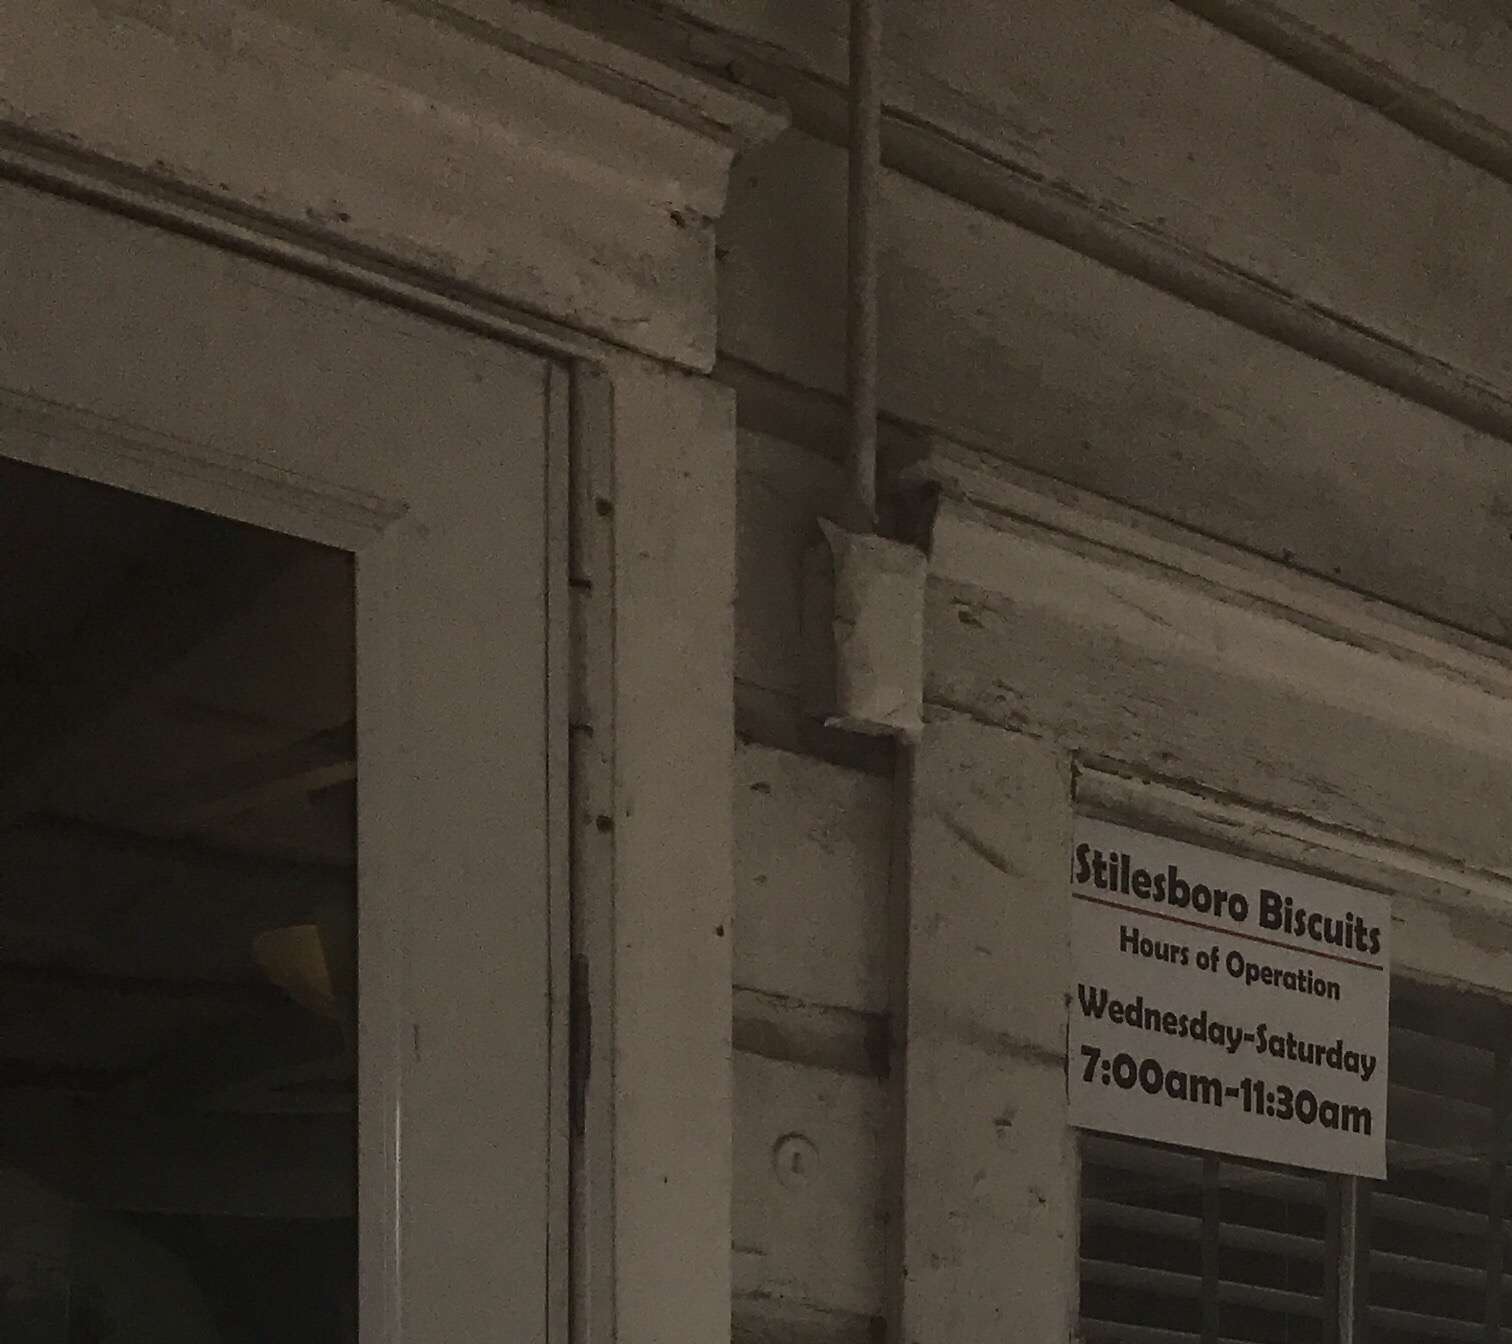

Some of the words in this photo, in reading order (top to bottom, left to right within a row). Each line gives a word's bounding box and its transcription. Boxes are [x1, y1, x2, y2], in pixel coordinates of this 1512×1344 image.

[1075, 843, 1249, 922] Stilesboro
[1258, 889, 1381, 955] Biscuits
[1119, 926, 1189, 966] Hours
[1196, 946, 1220, 973] of
[1225, 951, 1341, 1000] Operation
[1077, 984, 1377, 1081] Wednesday-Saturday
[1081, 1045, 1372, 1135] 7:00am-11:30am
